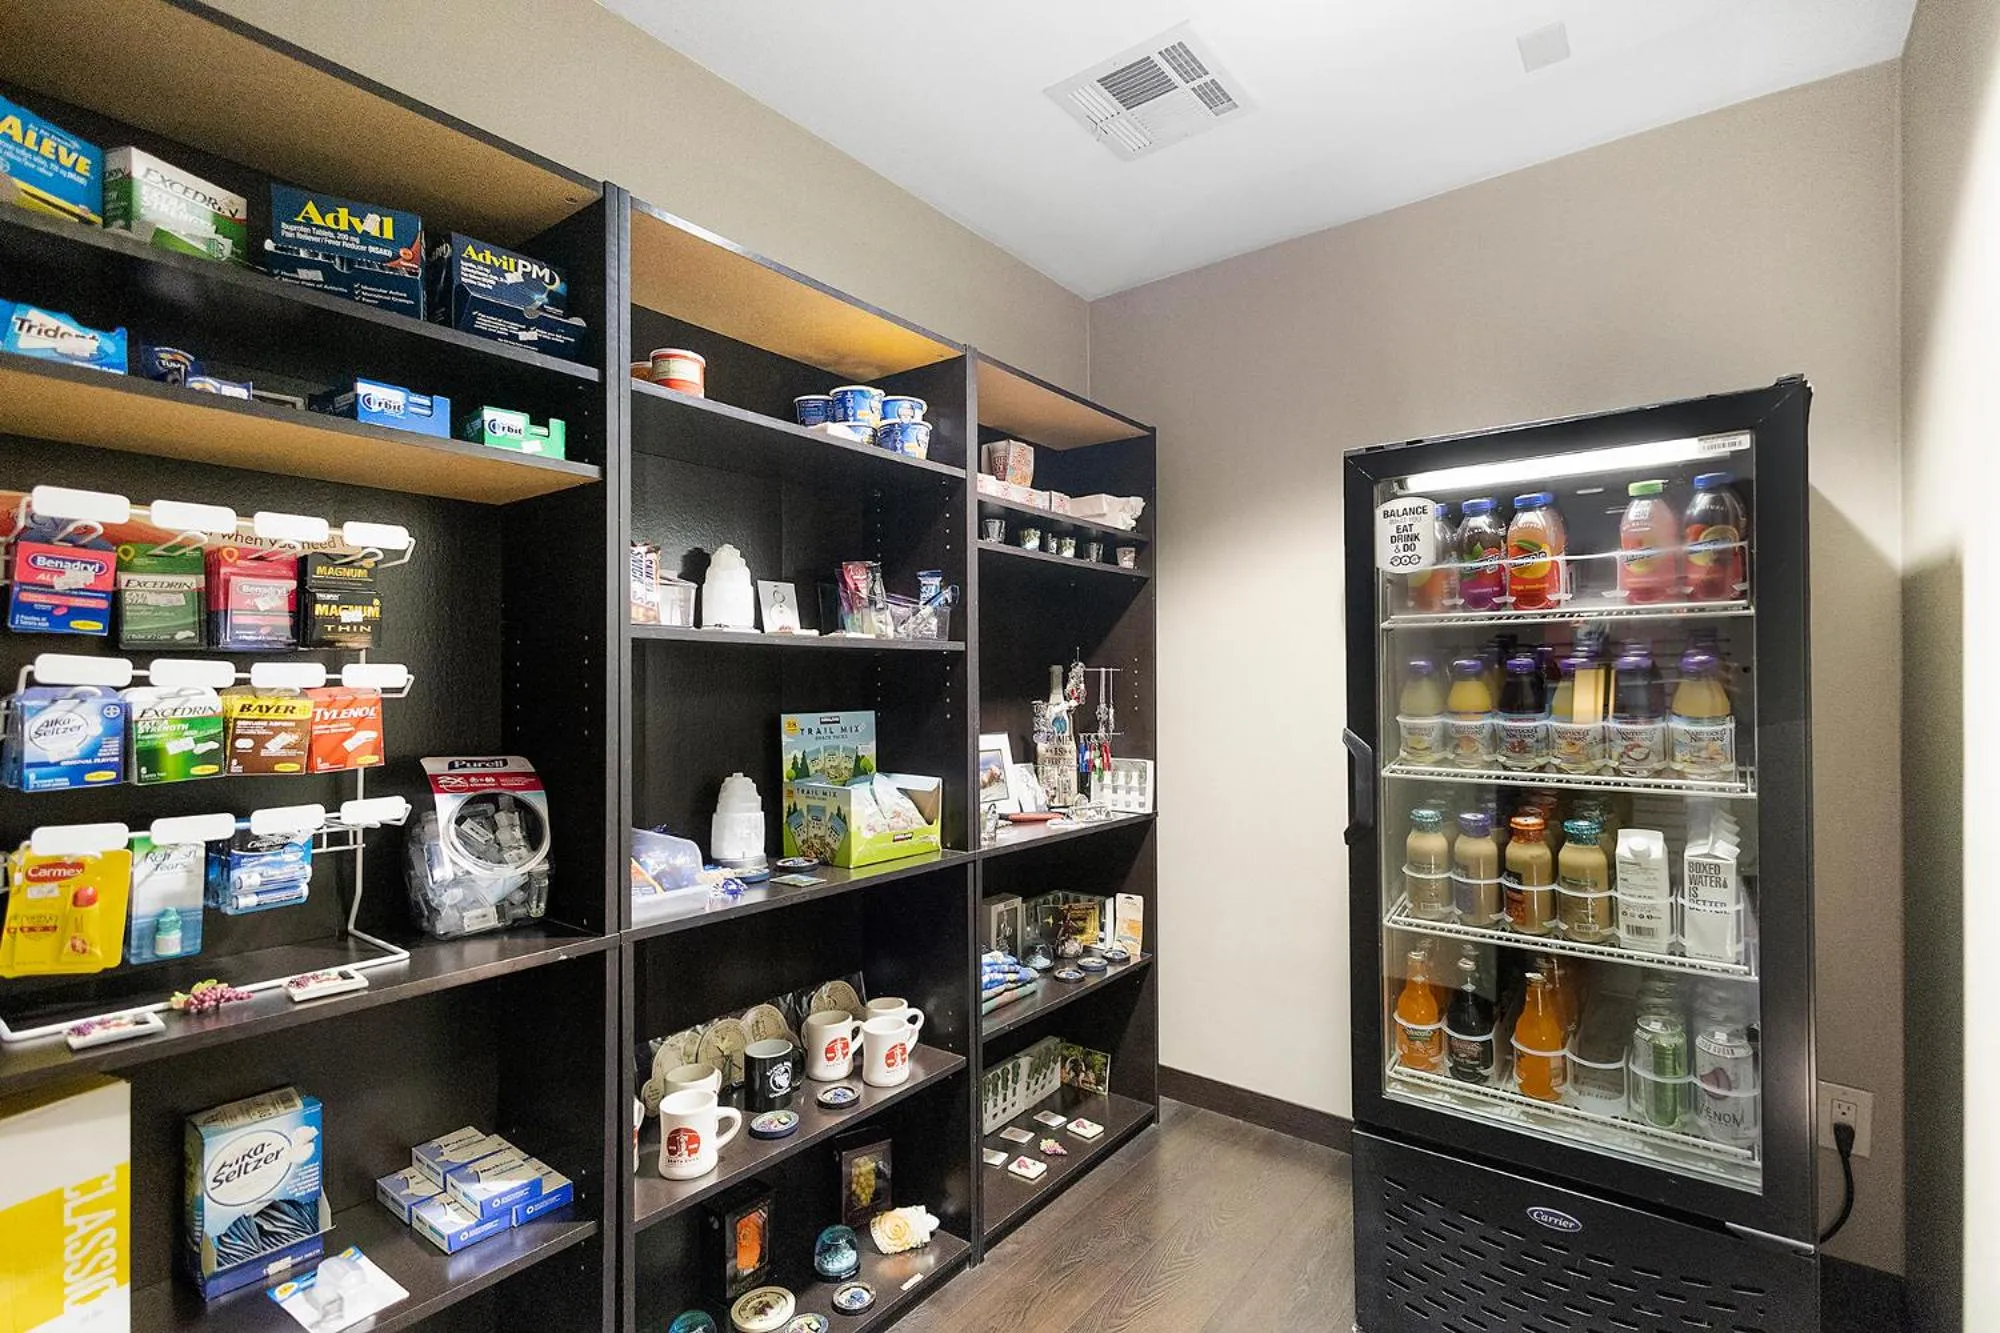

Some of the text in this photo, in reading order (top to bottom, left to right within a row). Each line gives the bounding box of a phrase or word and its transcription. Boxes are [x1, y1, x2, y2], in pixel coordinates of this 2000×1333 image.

[0, 115, 92, 178] ALEVE
[294, 200, 395, 241] Advil
[462, 244, 515, 272] Advil
[517, 259, 550, 283] PM
[488, 418, 523, 437] Orbit
[1383, 505, 1428, 519] BALANCE
[1396, 523, 1413, 534] EAT
[221, 534, 263, 546] when
[302, 540, 337, 550] need
[1390, 533, 1420, 544] DRINK
[1403, 543, 1416, 552] DO
[37, 556, 100, 574] Benadryl
[316, 565, 369, 578] MAGNUM
[125, 579, 193, 590] EXCEDRIN
[324, 624, 372, 633] THIN
[140, 706, 217, 719] EXCEDRIN
[239, 704, 296, 714] BAYER
[314, 706, 377, 722] TYLENOL
[33, 725, 84, 739] Seltzer
[800, 724, 860, 735] TRAIL MIX
[28, 867, 82, 878] Carmex
[1688, 861, 1720, 875] BOXED
[1688, 873, 1722, 888] WATER
[1689, 886, 1699, 898] IS
[1700, 1103, 1744, 1127] VENOM
[211, 1148, 285, 1192] Seltzer
[1533, 1210, 1576, 1229] Carrier
[64, 1166, 117, 1315] CLASSIC
